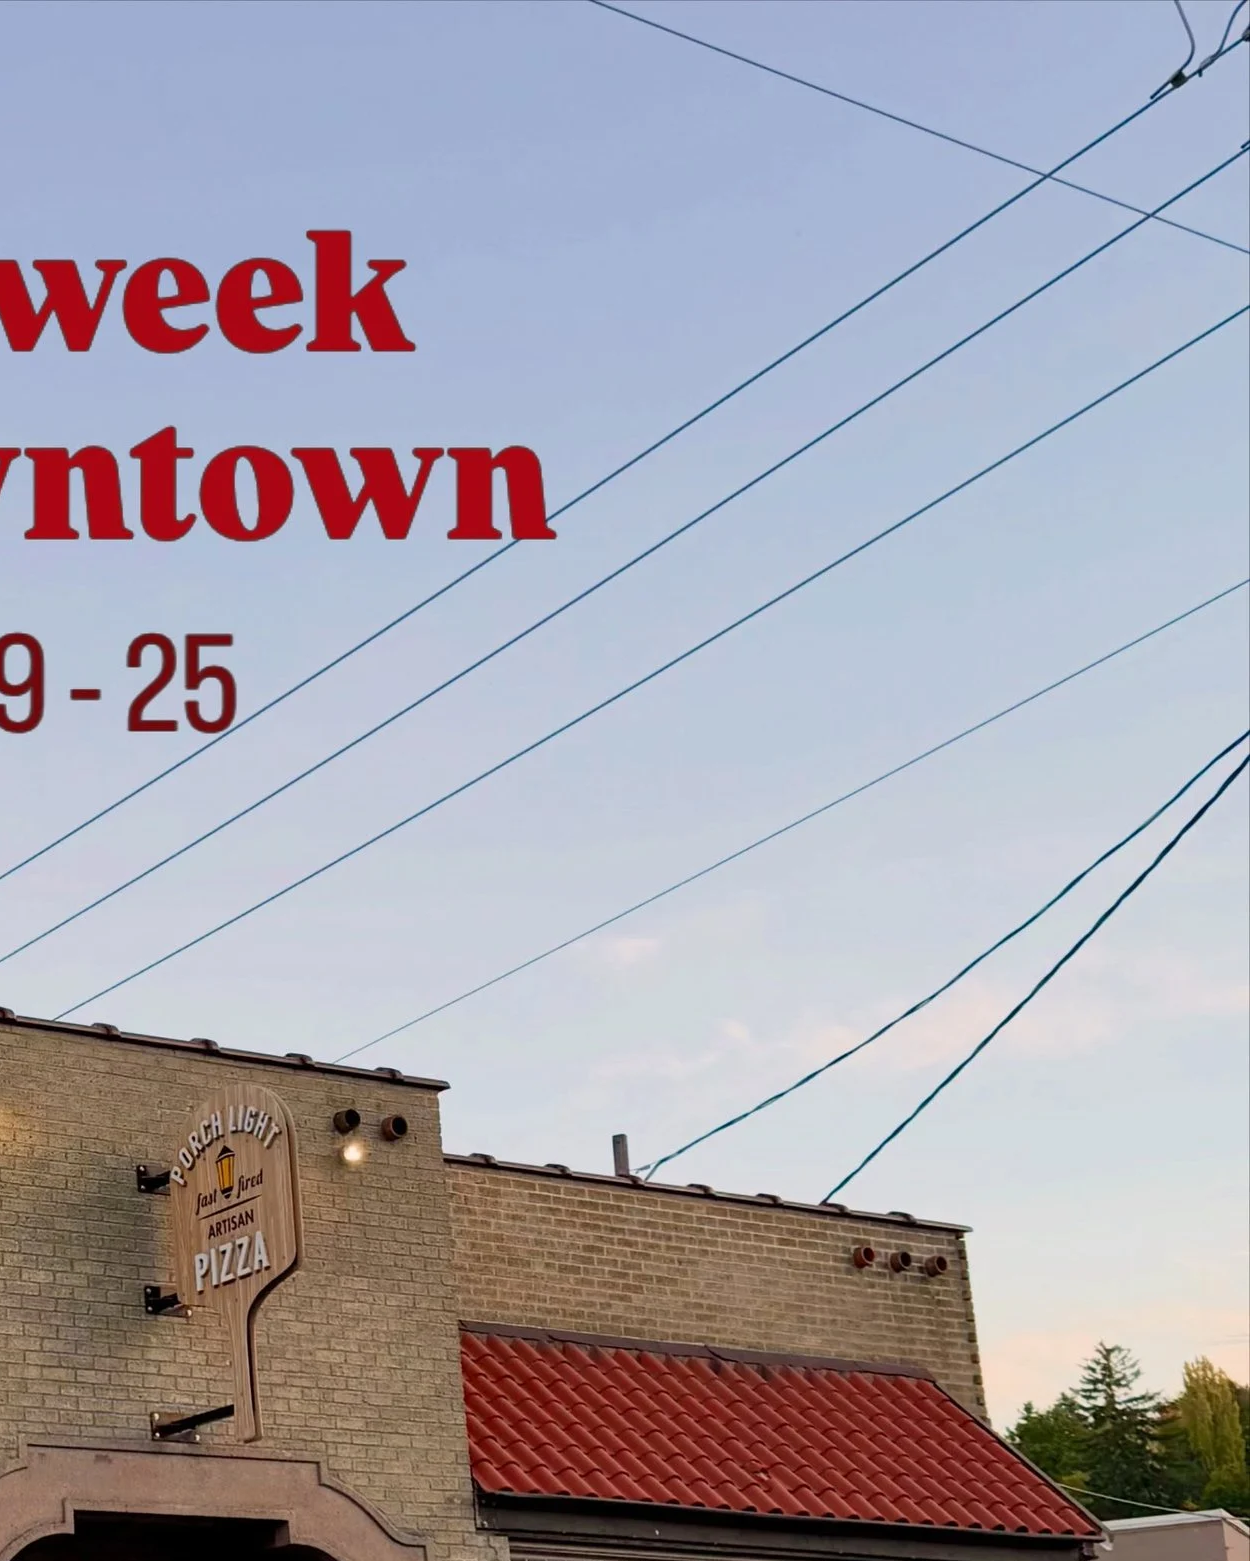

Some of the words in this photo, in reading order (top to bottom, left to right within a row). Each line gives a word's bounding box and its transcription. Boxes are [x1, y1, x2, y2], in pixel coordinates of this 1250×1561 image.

[170, 1110, 224, 1187] PORCH
[229, 1104, 282, 1149] LIGHT
[195, 1188, 217, 1216] fast
[236, 1168, 264, 1199] fired
[208, 1209, 254, 1239] ARTISAN
[194, 1231, 271, 1294] PIZZA
